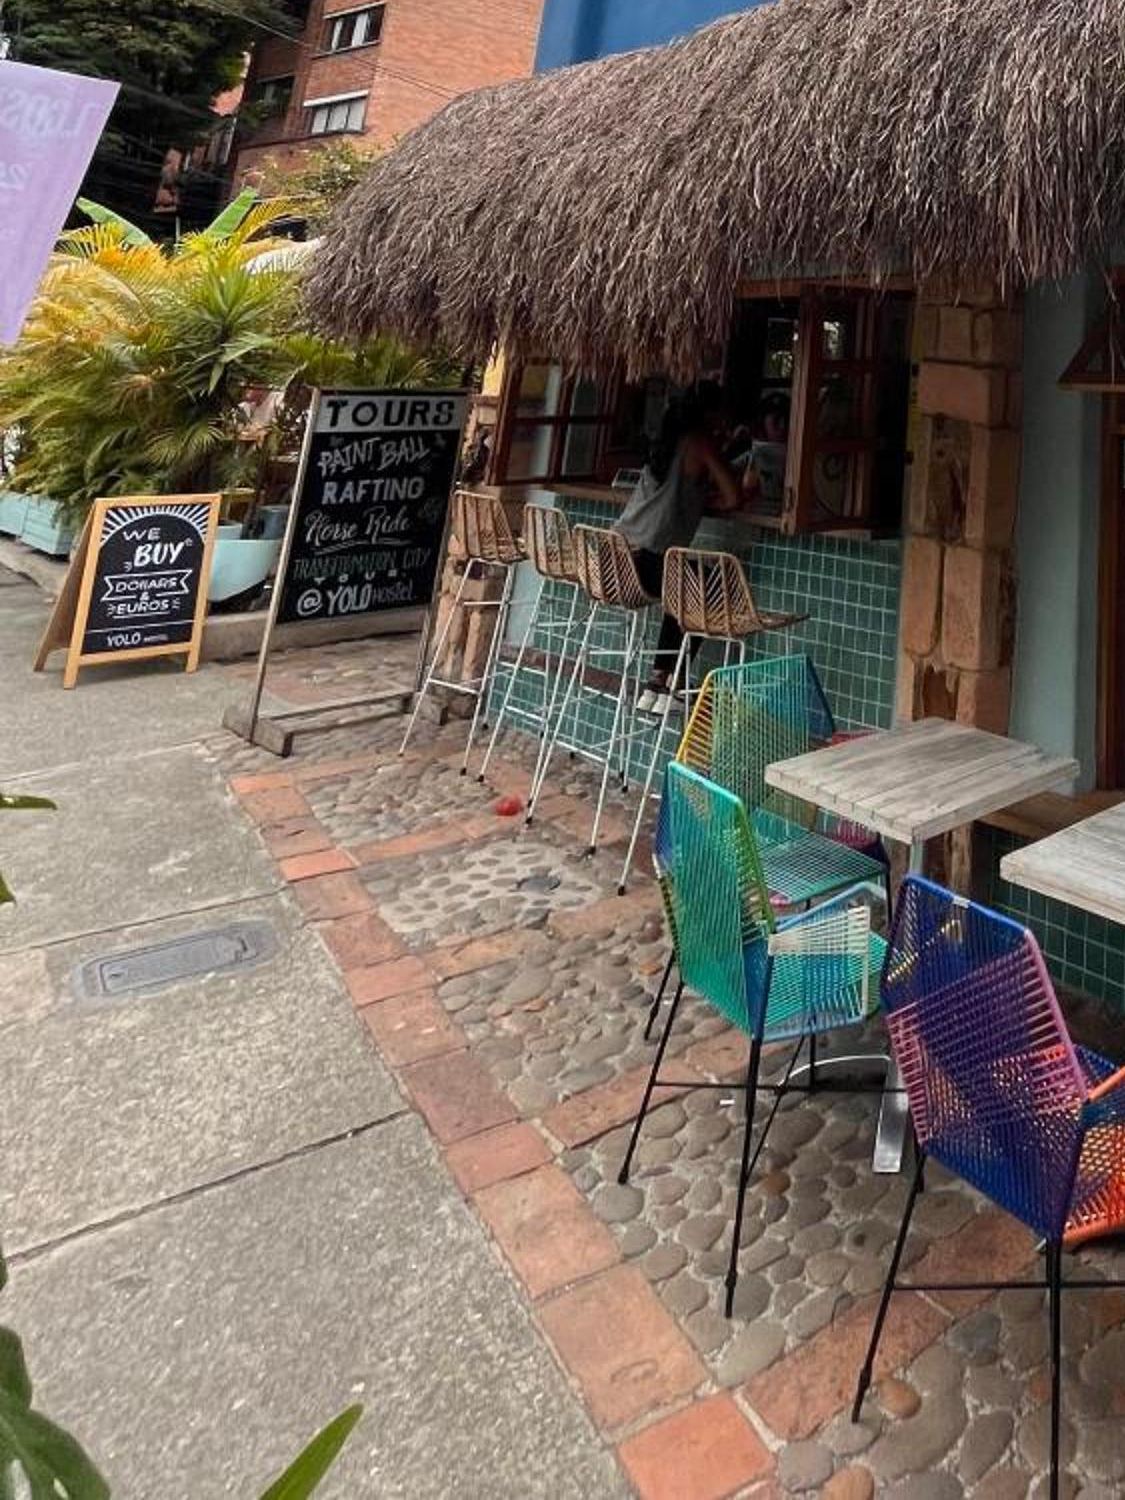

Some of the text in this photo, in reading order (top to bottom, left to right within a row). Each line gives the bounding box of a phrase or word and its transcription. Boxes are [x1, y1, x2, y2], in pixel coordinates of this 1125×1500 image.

[327, 399, 454, 427] TOURS
[318, 434, 431, 476] PAINT BALL
[321, 476, 424, 505] RAFTING
[122, 527, 161, 541] WE
[133, 541, 184, 567] BUY
[117, 599, 170, 615] EUROS
[327, 583, 373, 615] YOLO
[106, 632, 141, 647] YOLO
